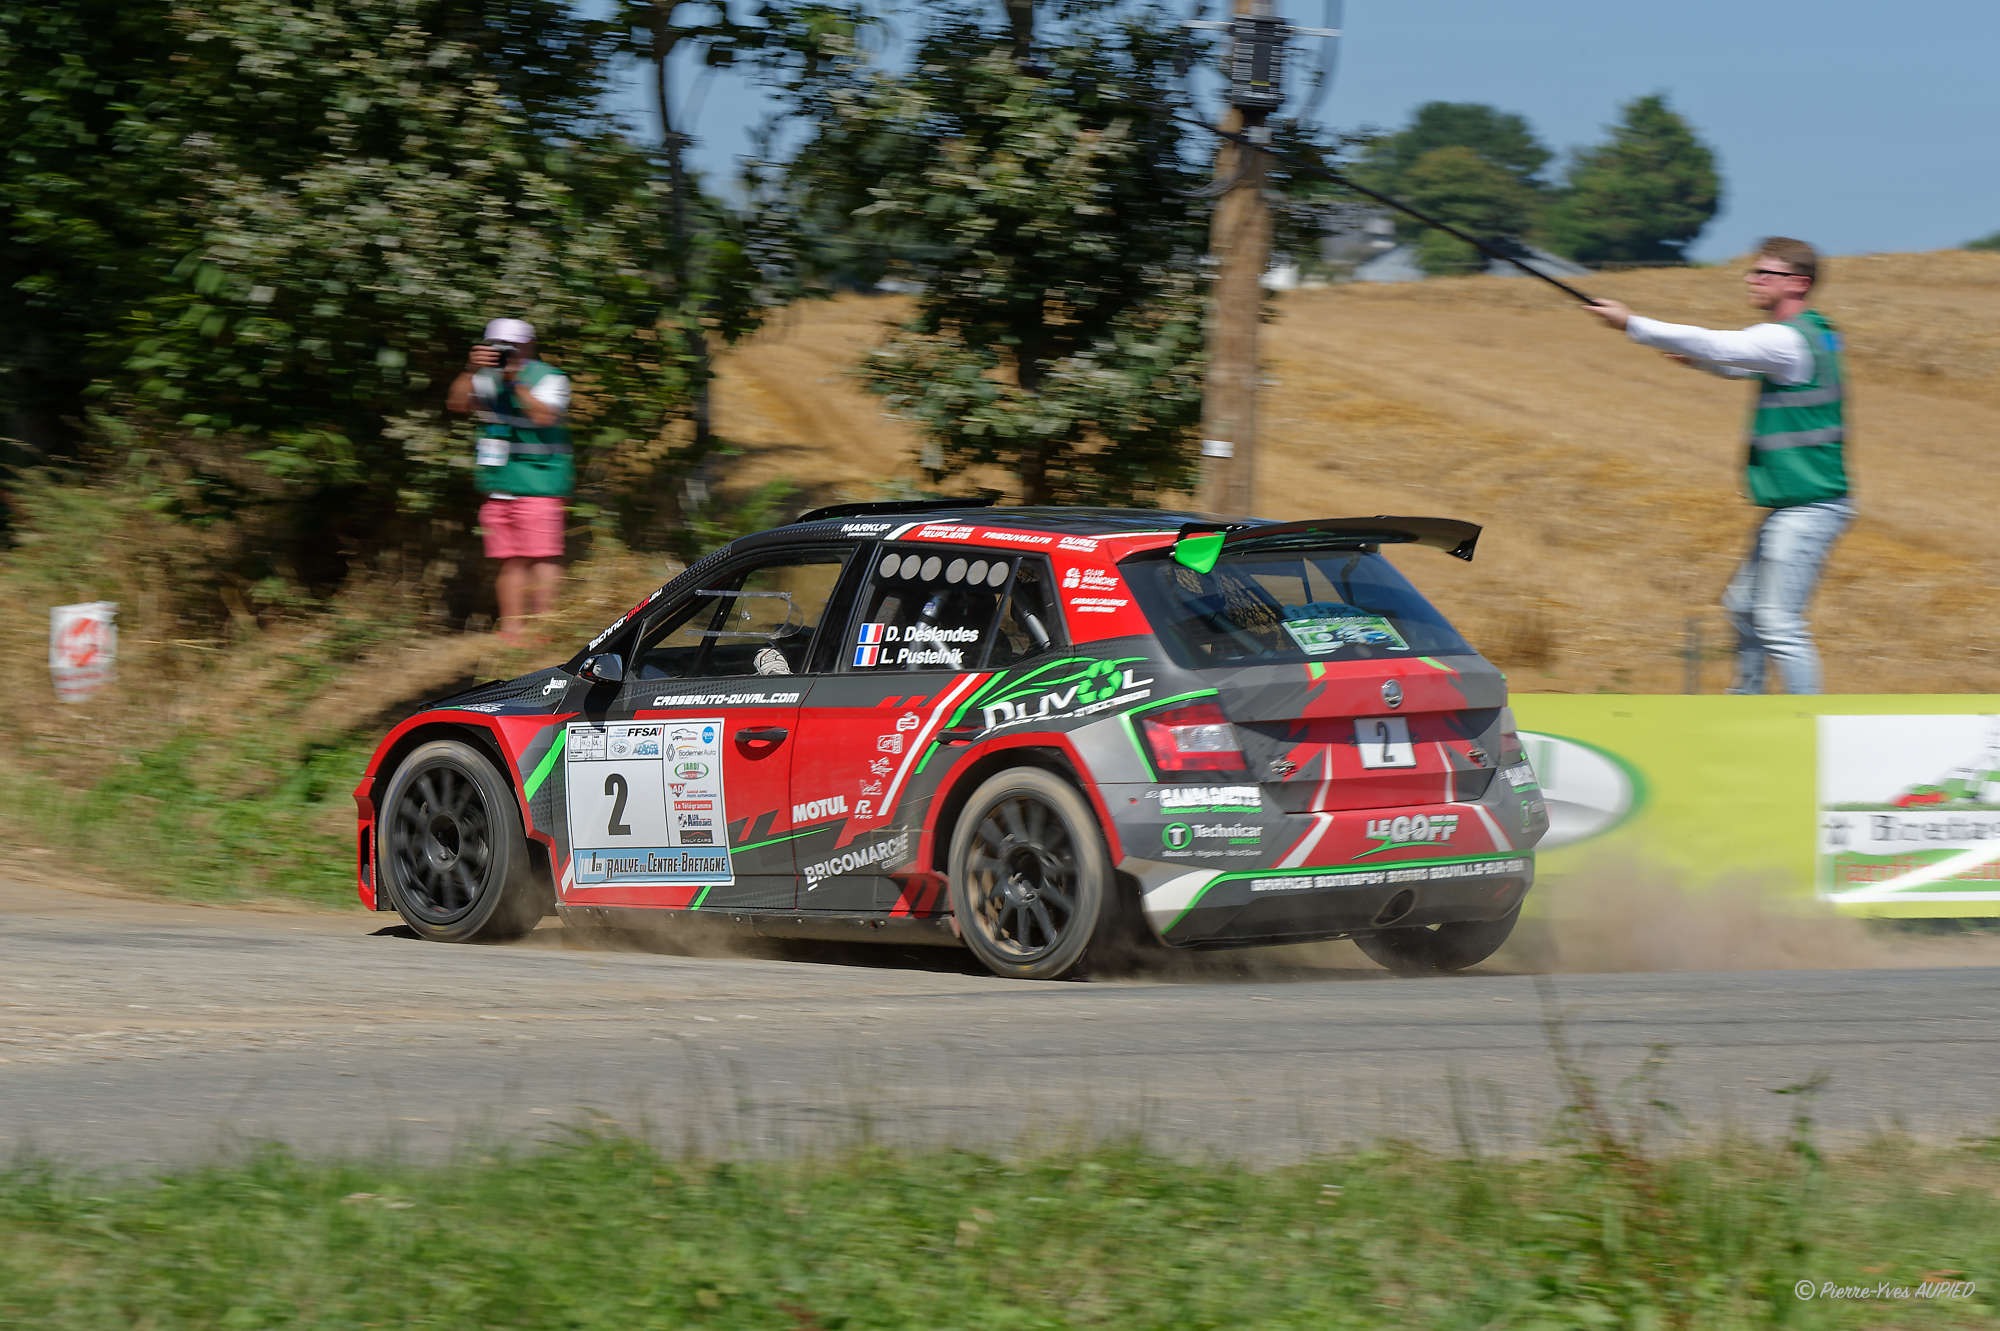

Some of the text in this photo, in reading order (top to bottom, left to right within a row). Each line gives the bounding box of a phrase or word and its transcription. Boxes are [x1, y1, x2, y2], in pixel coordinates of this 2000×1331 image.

[841, 524, 891, 532] MARKUP
[885, 626, 979, 642] D. Deslandes
[880, 648, 965, 664] L. Pustelnik
[653, 693, 800, 706] CASSEAUTO-DUVAL.COM
[627, 728, 658, 737] FFSA
[1376, 721, 1395, 763] 2
[604, 773, 632, 836] 2
[792, 795, 849, 823] MOTUL
[1191, 823, 1264, 838] Technicar
[804, 825, 909, 885] BRICOMARCHÉ
[606, 859, 638, 879] RALLYE
[648, 852, 726, 873] CENTRE-BRETAGNE
